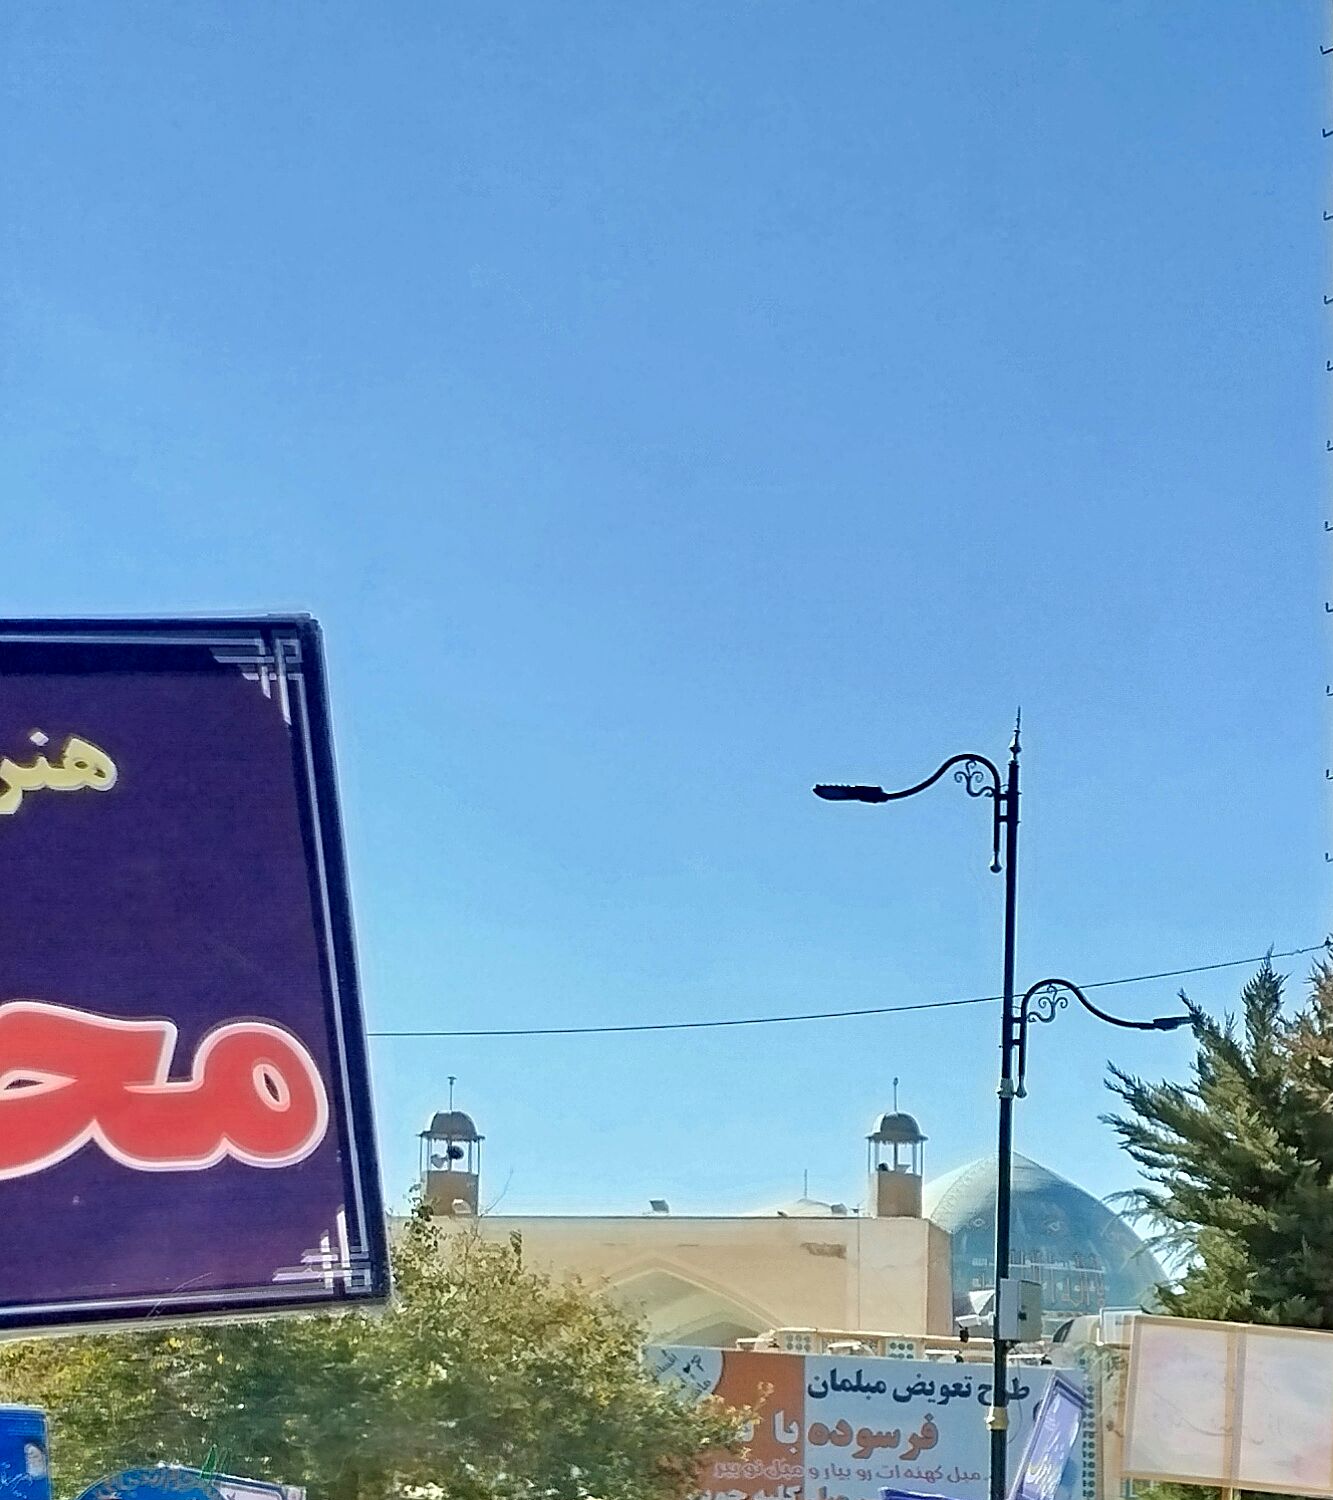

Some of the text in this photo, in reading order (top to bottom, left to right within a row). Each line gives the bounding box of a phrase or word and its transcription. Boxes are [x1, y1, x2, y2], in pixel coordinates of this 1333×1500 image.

[807, 1368, 1030, 1406] طح تعویض مبلمان
[773, 1409, 799, 1454] با
[808, 1412, 939, 1460] فرسوده
[823, 1463, 851, 1480] بیار
[876, 1464, 900, 1480] ات
[905, 1464, 943, 1481] کهنه
